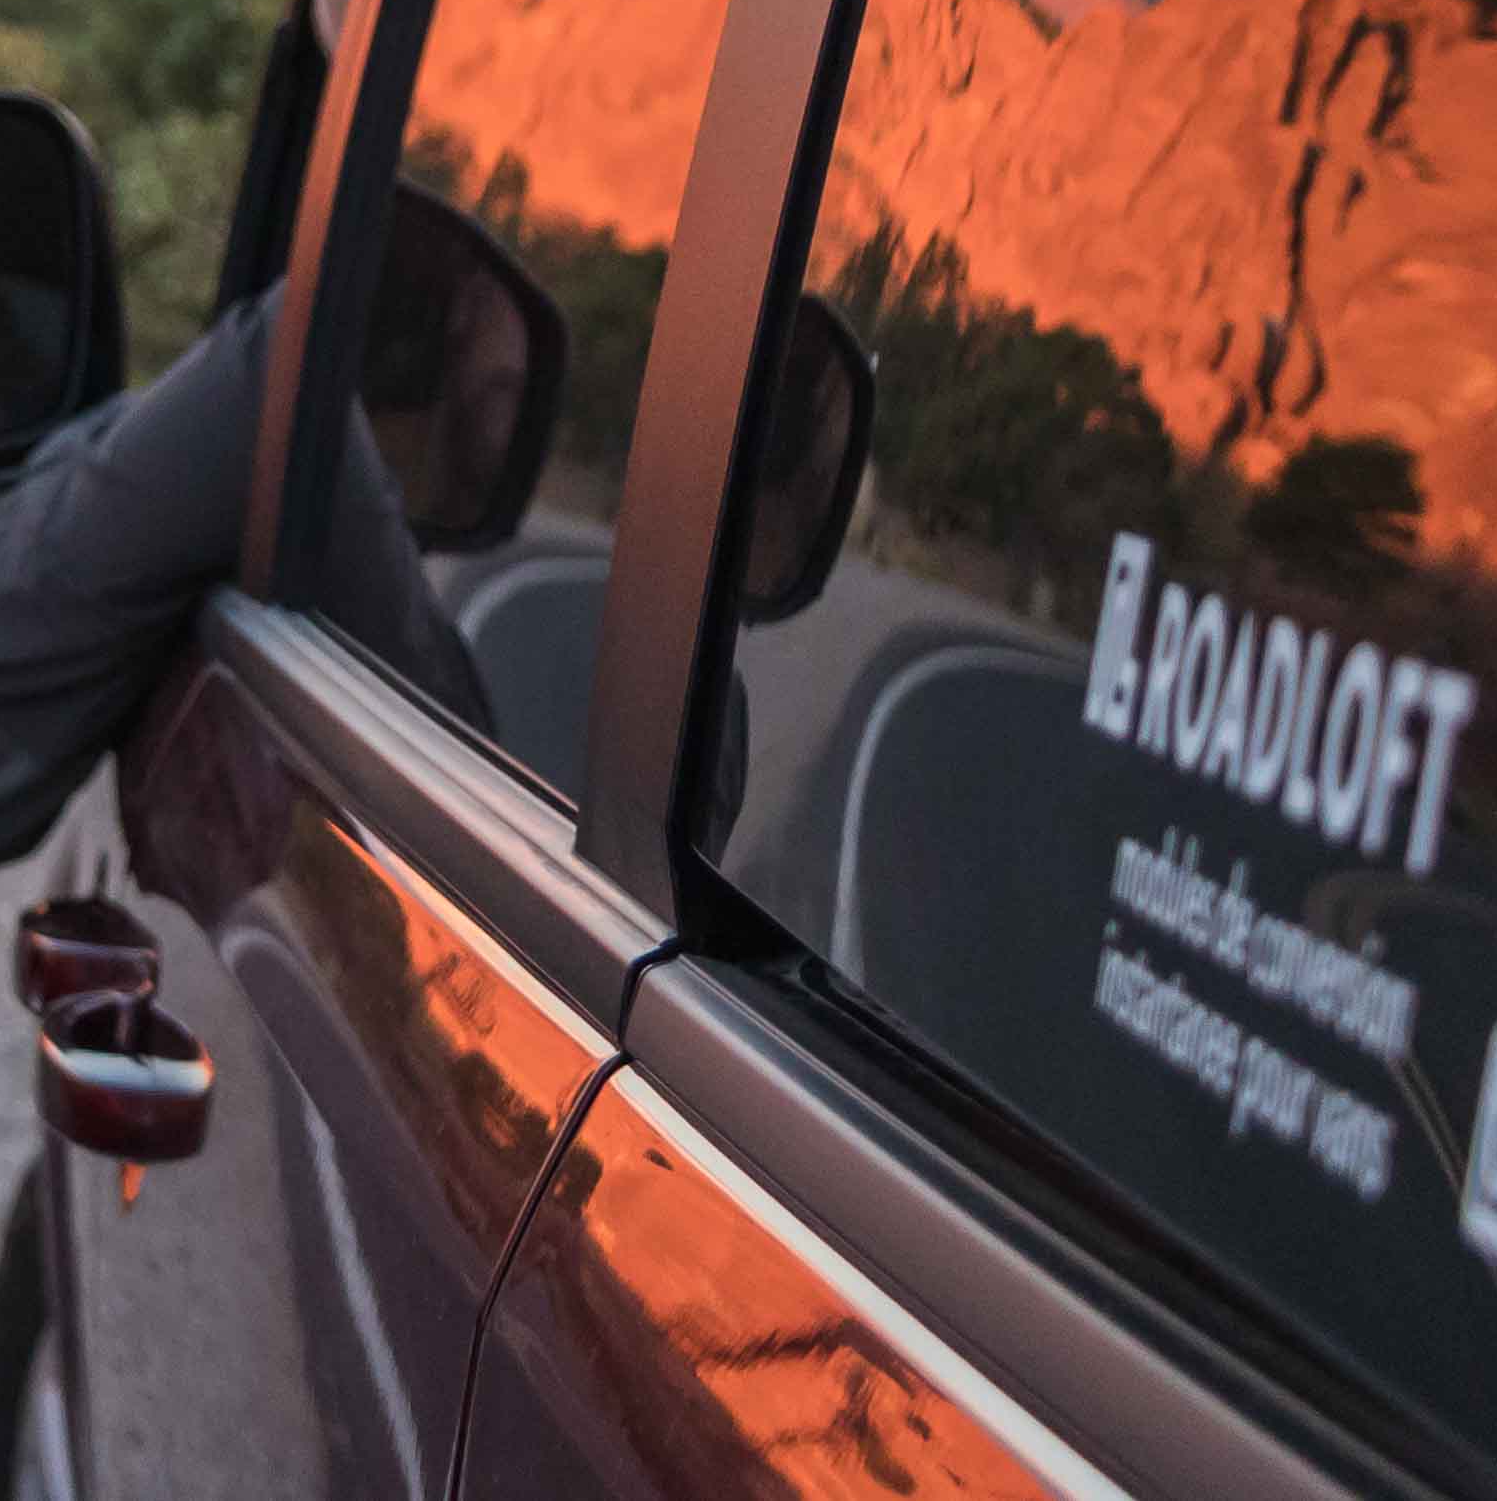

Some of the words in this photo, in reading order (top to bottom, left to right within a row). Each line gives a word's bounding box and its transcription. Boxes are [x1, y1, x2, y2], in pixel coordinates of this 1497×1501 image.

[1136, 582, 1477, 877] ROADLOFT
[1212, 858, 1256, 970] de
[1247, 930, 1419, 1060] conversion
[1229, 1036, 1315, 1139] pour
[1309, 1090, 1395, 1205] vans
